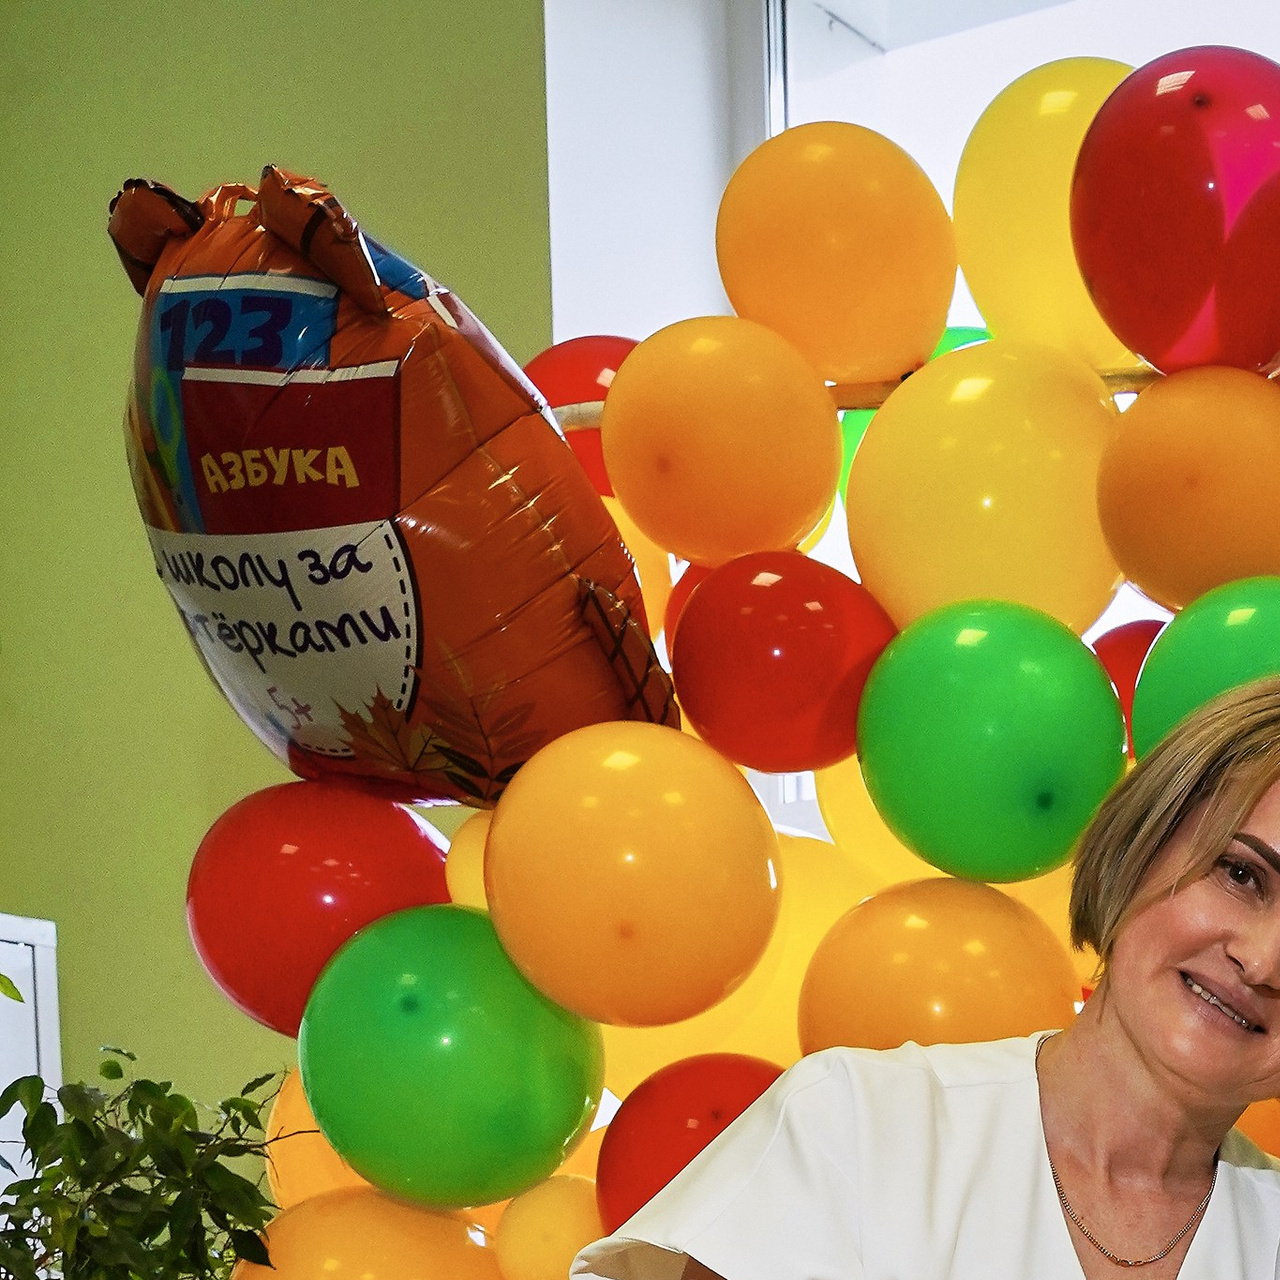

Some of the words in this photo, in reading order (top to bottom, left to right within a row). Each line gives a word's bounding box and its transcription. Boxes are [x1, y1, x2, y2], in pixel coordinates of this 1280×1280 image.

[160, 296, 293, 372] 123
[201, 446, 360, 494] АЗБУКА
[298, 544, 373, 585] за
[191, 606, 402, 674] тёрками
